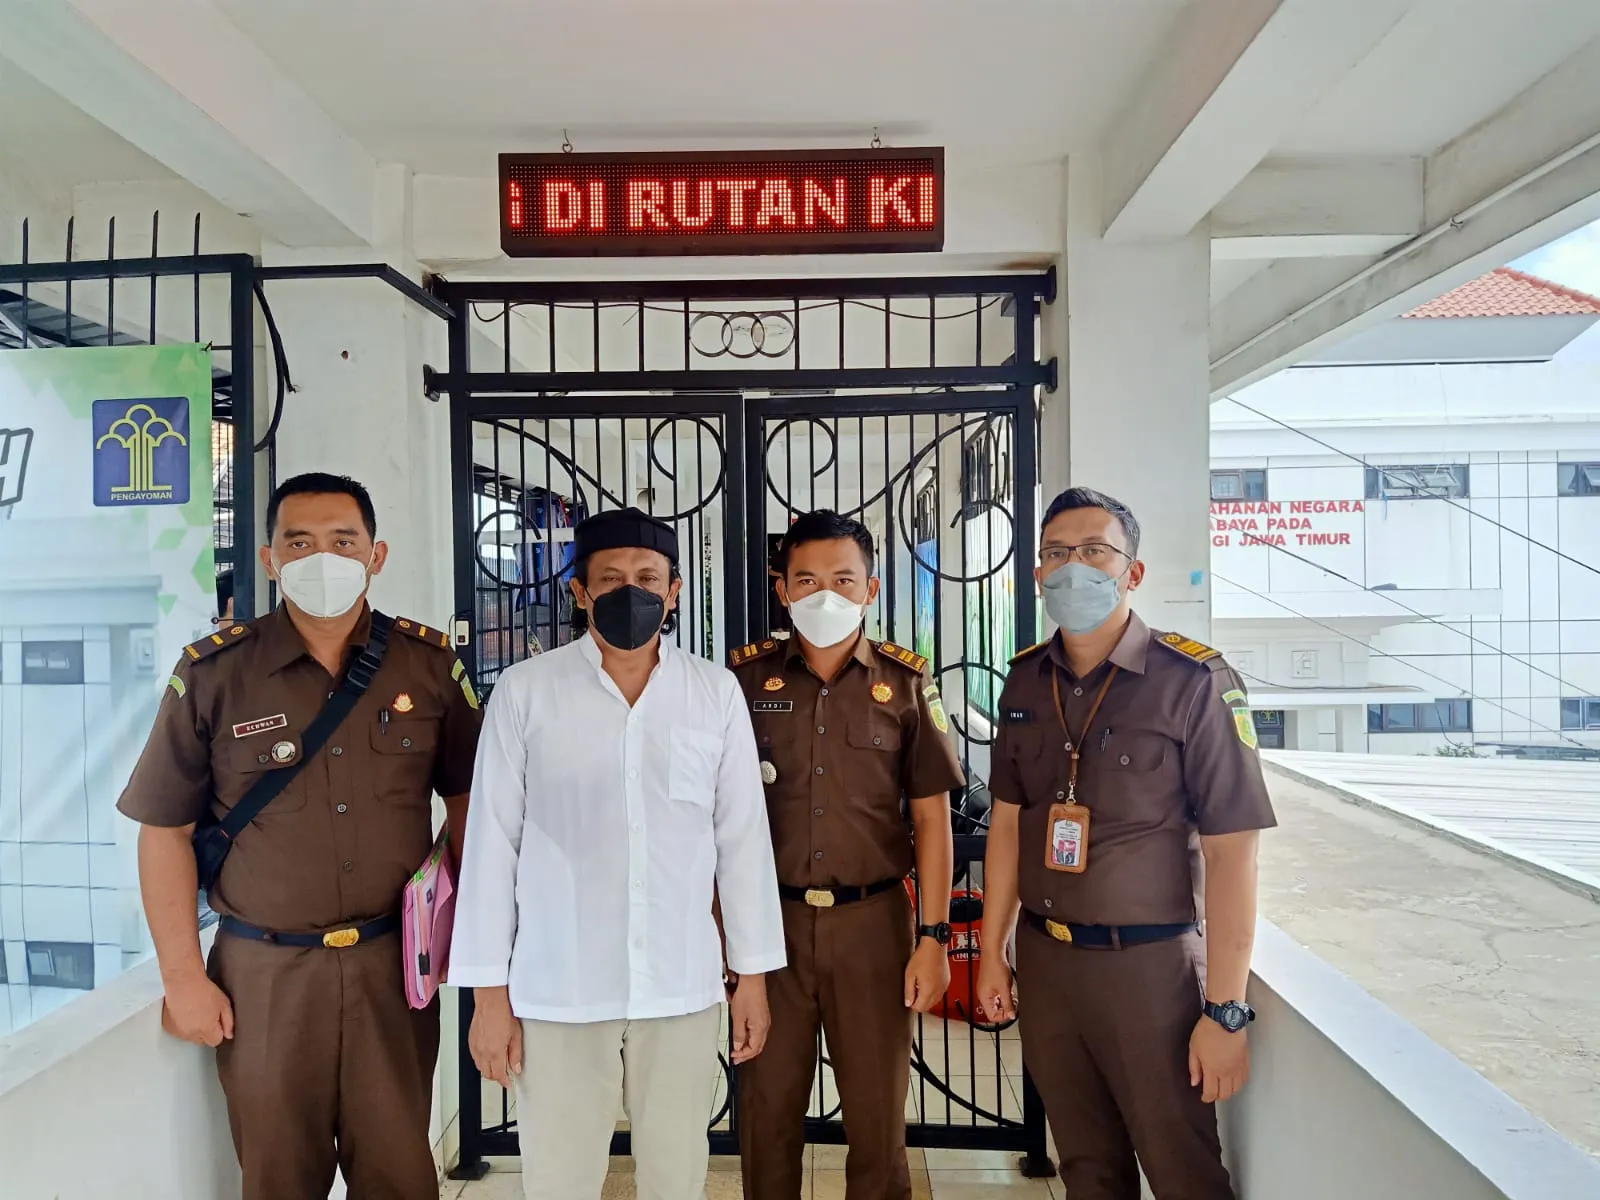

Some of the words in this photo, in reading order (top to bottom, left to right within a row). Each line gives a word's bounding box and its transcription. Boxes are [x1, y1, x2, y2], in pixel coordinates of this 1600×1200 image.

[545, 181, 604, 228] DI
[628, 179, 844, 227] RUTAN
[110, 491, 173, 501] PENGAYOMAN
[1289, 500, 1364, 514] NEGARA
[1267, 517, 1313, 530] PADA
[1212, 535, 1230, 547] GI
[1238, 533, 1286, 547] JAWA
[1296, 533, 1351, 546] TIMUR
